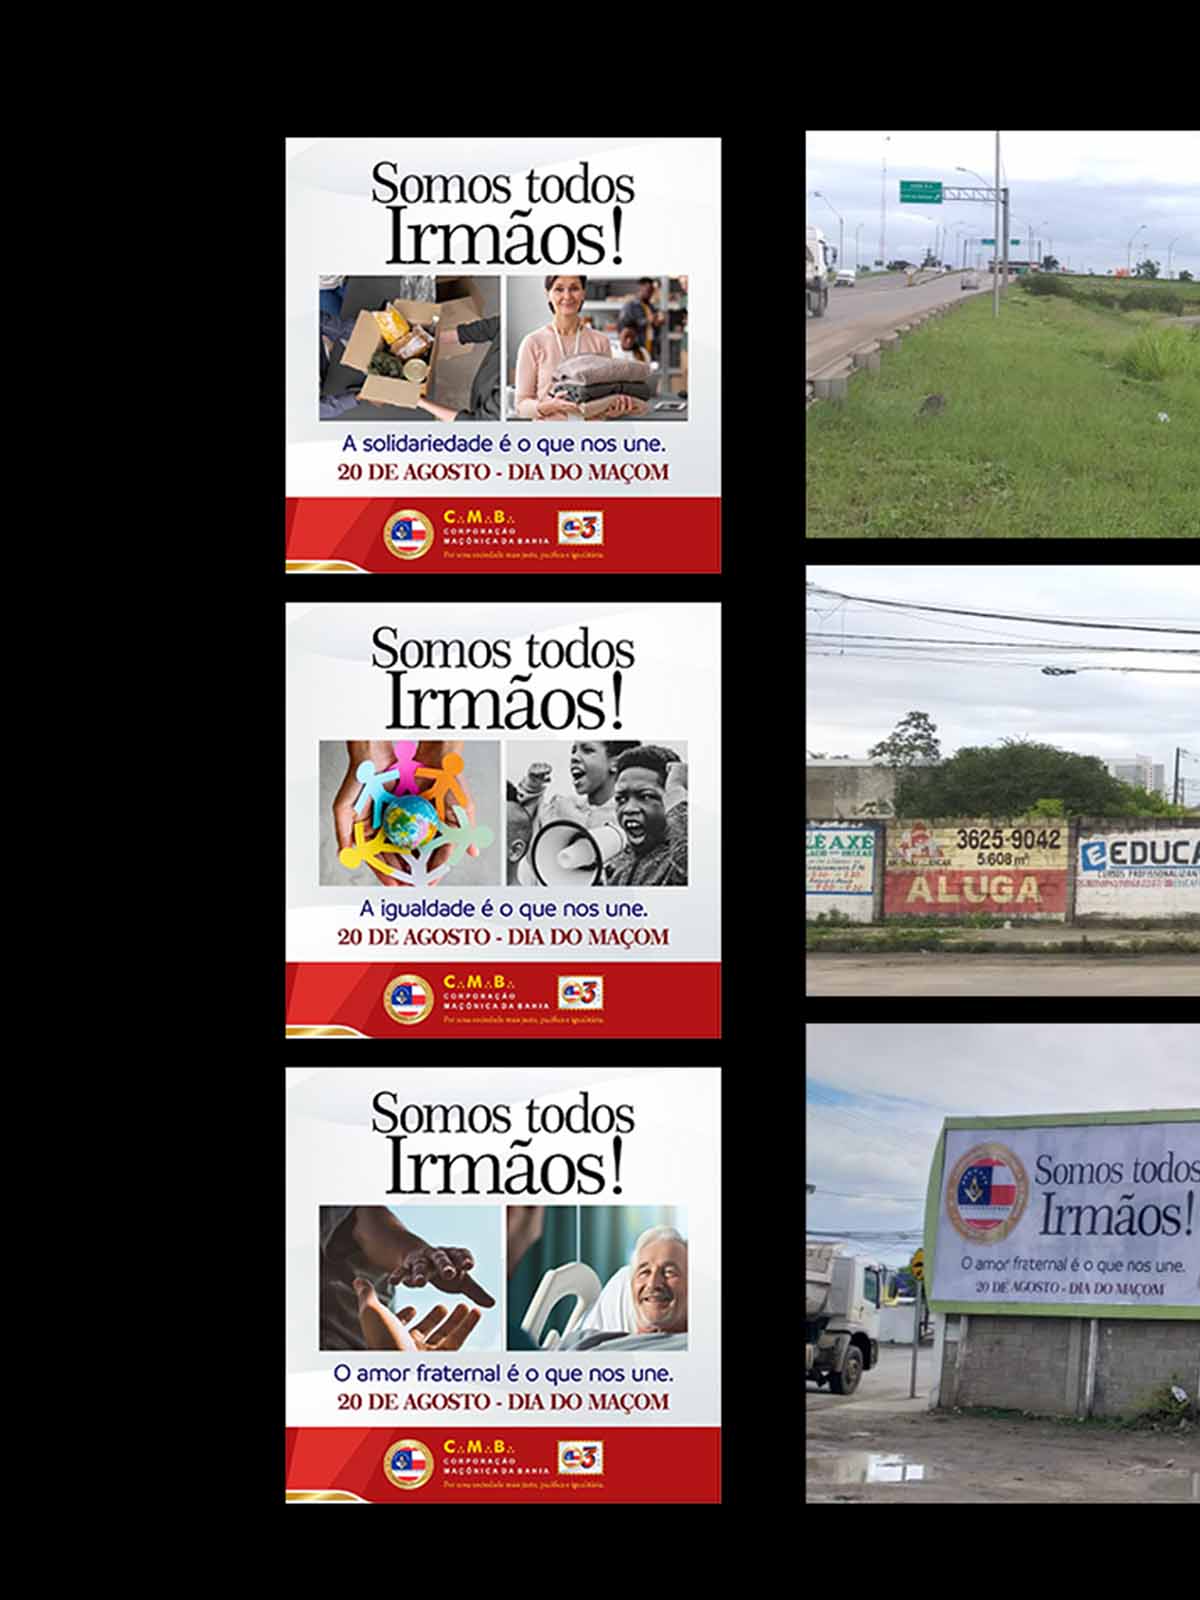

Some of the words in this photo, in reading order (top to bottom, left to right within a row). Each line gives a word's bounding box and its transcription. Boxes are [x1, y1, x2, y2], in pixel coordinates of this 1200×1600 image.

[372, 161, 511, 204] Somos
[527, 162, 635, 204] todos
[385, 205, 623, 265] Irmãos!
[343, 436, 357, 452] A
[363, 435, 493, 452] solidariedade
[500, 435, 511, 452] é
[518, 439, 531, 452] o
[537, 439, 575, 456] que
[582, 439, 617, 452] nos
[624, 439, 666, 452] une.
[337, 464, 362, 481] 20
[368, 464, 398, 481] DE
[403, 464, 490, 481] AGOSTO
[509, 464, 543, 481] DIA
[550, 464, 582, 481] DO
[588, 464, 669, 484] MAÇOM
[372, 626, 511, 669] Somos
[527, 627, 635, 669] todos
[385, 670, 623, 730] Irmãos!
[957, 829, 1061, 850] 3625-9042
[906, 876, 1043, 903] ALUGA
[360, 901, 374, 917] A
[381, 900, 475, 921] igualdade
[482, 900, 493, 917] é
[499, 904, 513, 917] o
[519, 904, 557, 921] que
[564, 904, 599, 917] nos
[606, 904, 648, 917] une.
[337, 929, 362, 946] 20
[368, 929, 398, 946] DE
[403, 929, 490, 946] AGOSTO
[509, 929, 543, 946] DIA
[550, 929, 582, 946] DO
[588, 929, 669, 949] MAÇOM
[372, 1091, 511, 1134] Somos
[527, 1092, 635, 1134] todos
[385, 1135, 623, 1195] Irmãos!
[1035, 1154, 1123, 1186] Somos
[1038, 1190, 1194, 1236] Irmãos!
[961, 1256, 972, 1270] O
[975, 1259, 1010, 1271] amor
[1013, 1256, 1066, 1271] fraternal
[1071, 1257, 1080, 1270] é
[1084, 1261, 1092, 1270] o
[1097, 1260, 1124, 1274] que
[1128, 1262, 1150, 1272] nos
[1156, 1262, 1185, 1272] une.
[976, 1282, 989, 1292] 20
[992, 1280, 1010, 1292] DE
[1012, 1281, 1059, 1294] AGOSTO
[1070, 1282, 1090, 1294] DIA
[1094, 1284, 1112, 1294] DO
[1114, 1282, 1164, 1298] MAÇOM
[334, 1365, 351, 1382] O
[357, 1369, 411, 1382] amor
[416, 1365, 500, 1382] fraternal
[507, 1365, 518, 1382] é
[525, 1369, 538, 1382] o
[545, 1369, 583, 1386] que
[589, 1369, 625, 1382] nos
[632, 1369, 674, 1382] une.
[337, 1394, 362, 1411] 20
[368, 1394, 398, 1411] DE
[403, 1394, 490, 1411] AGOSTO
[509, 1394, 543, 1411] DIA
[550, 1394, 582, 1411] DO
[588, 1394, 669, 1414] MAÇOM
